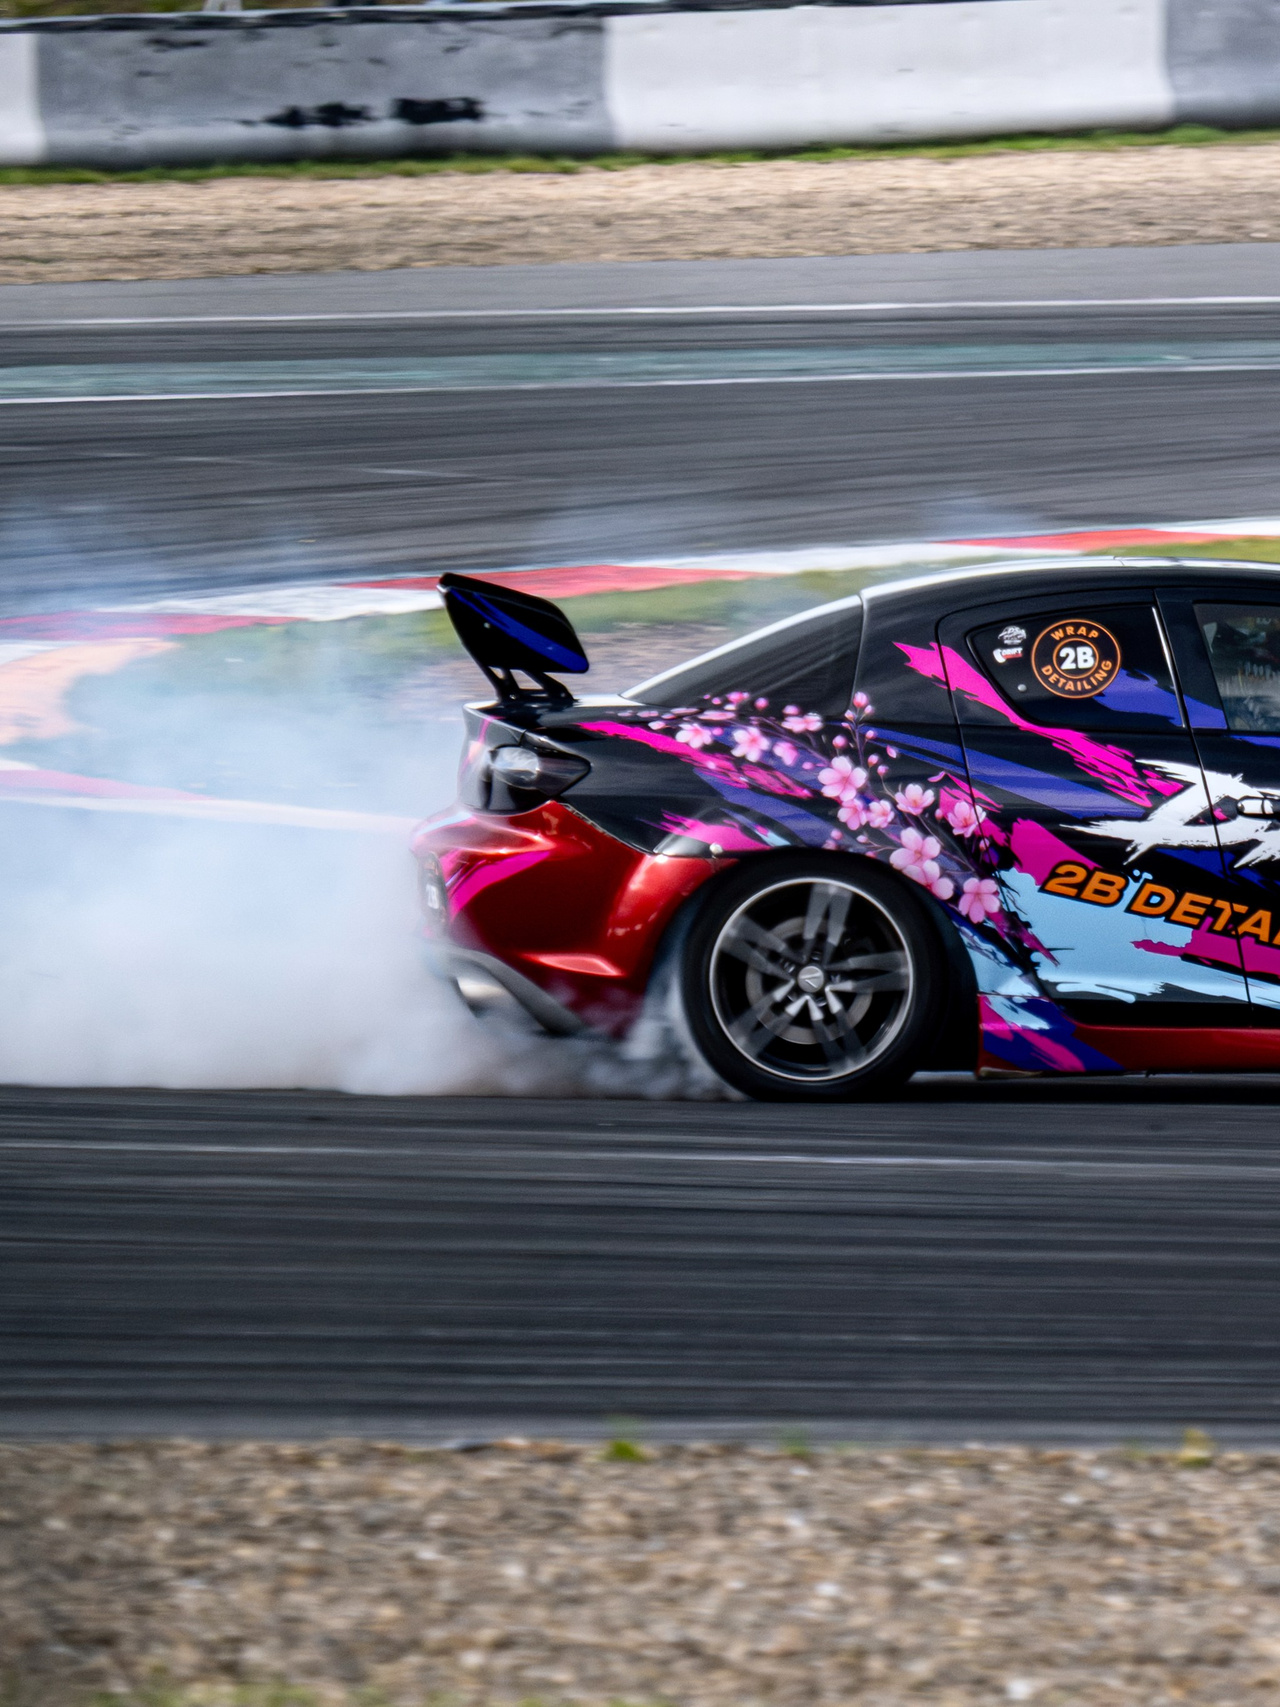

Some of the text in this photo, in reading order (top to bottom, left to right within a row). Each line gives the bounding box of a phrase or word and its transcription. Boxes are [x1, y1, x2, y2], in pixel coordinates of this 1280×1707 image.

[1051, 626, 1099, 641] WRAP
[1059, 646, 1095, 669] 2B
[1041, 660, 1112, 691] DETAILING
[1043, 863, 1127, 906] 2B
